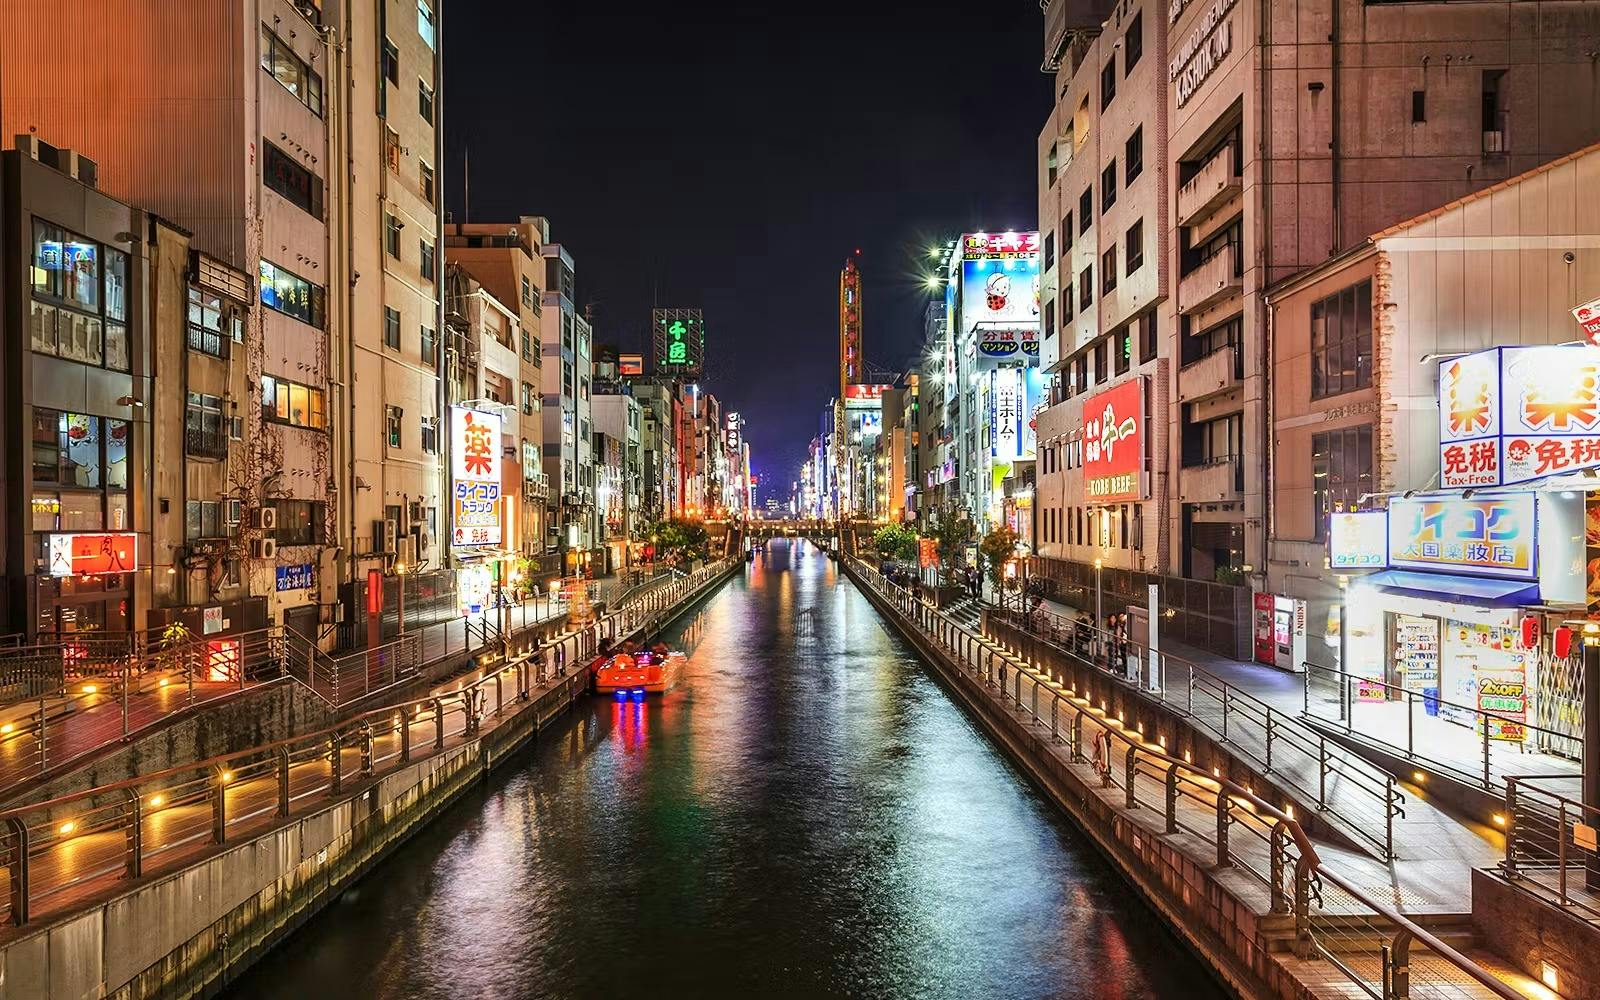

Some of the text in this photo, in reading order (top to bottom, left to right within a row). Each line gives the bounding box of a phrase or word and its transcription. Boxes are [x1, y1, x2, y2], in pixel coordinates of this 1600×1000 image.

[669, 321, 686, 363] 千房
[464, 411, 492, 475] 薬
[1444, 441, 1497, 475] 免税
[1534, 439, 1600, 475] 免税
[1090, 476, 1131, 496] KOBE BEEF
[1445, 474, 1495, 486] Tax-Free
[1480, 677, 1523, 697] 2%OFF
